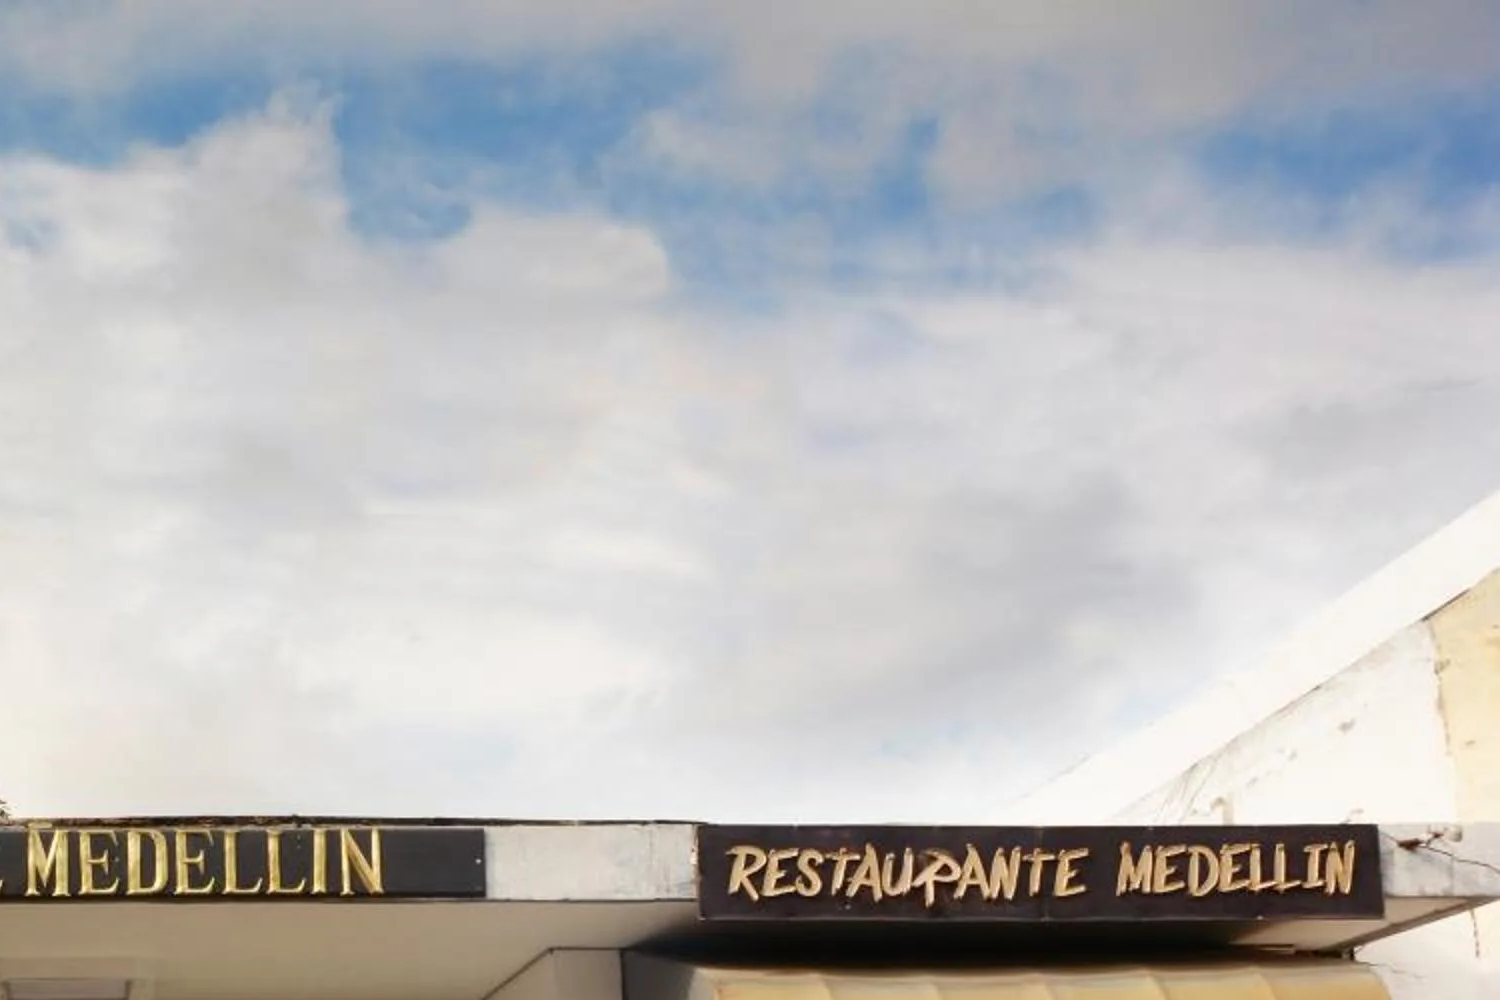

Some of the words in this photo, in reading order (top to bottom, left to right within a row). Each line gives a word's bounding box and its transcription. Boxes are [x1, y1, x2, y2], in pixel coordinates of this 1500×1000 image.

[23, 829, 385, 896] MEDELLIN
[726, 842, 1089, 907] RESTAURANTE
[1116, 840, 1356, 896] MEDELLIN
